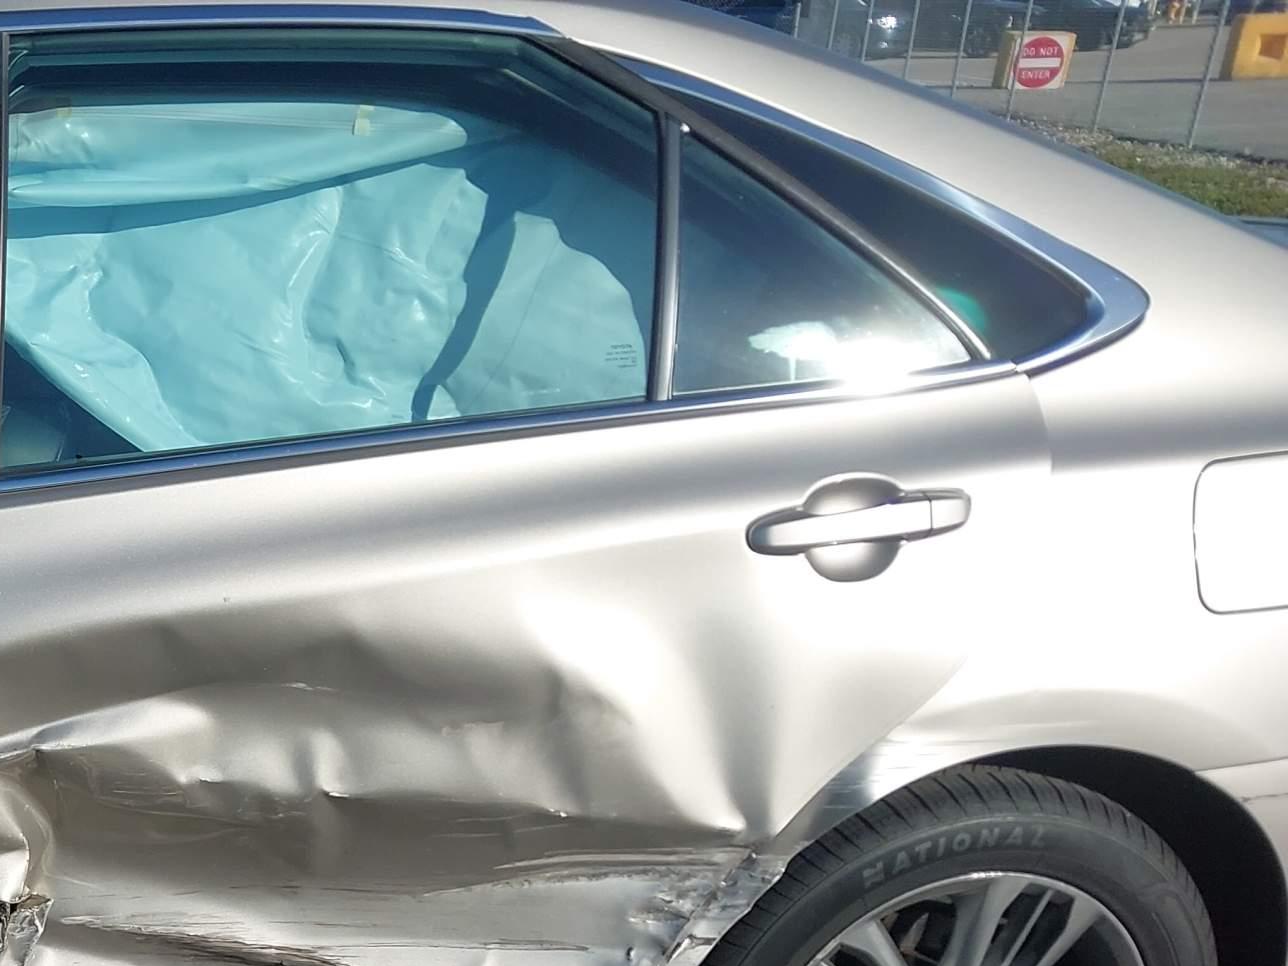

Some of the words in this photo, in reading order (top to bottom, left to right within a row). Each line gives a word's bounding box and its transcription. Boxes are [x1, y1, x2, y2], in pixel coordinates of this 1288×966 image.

[1023, 47, 1036, 56] DO
[1040, 47, 1059, 56] NOT
[1021, 70, 1050, 79] ENTER
[862, 825, 1045, 889] NATIONAL
